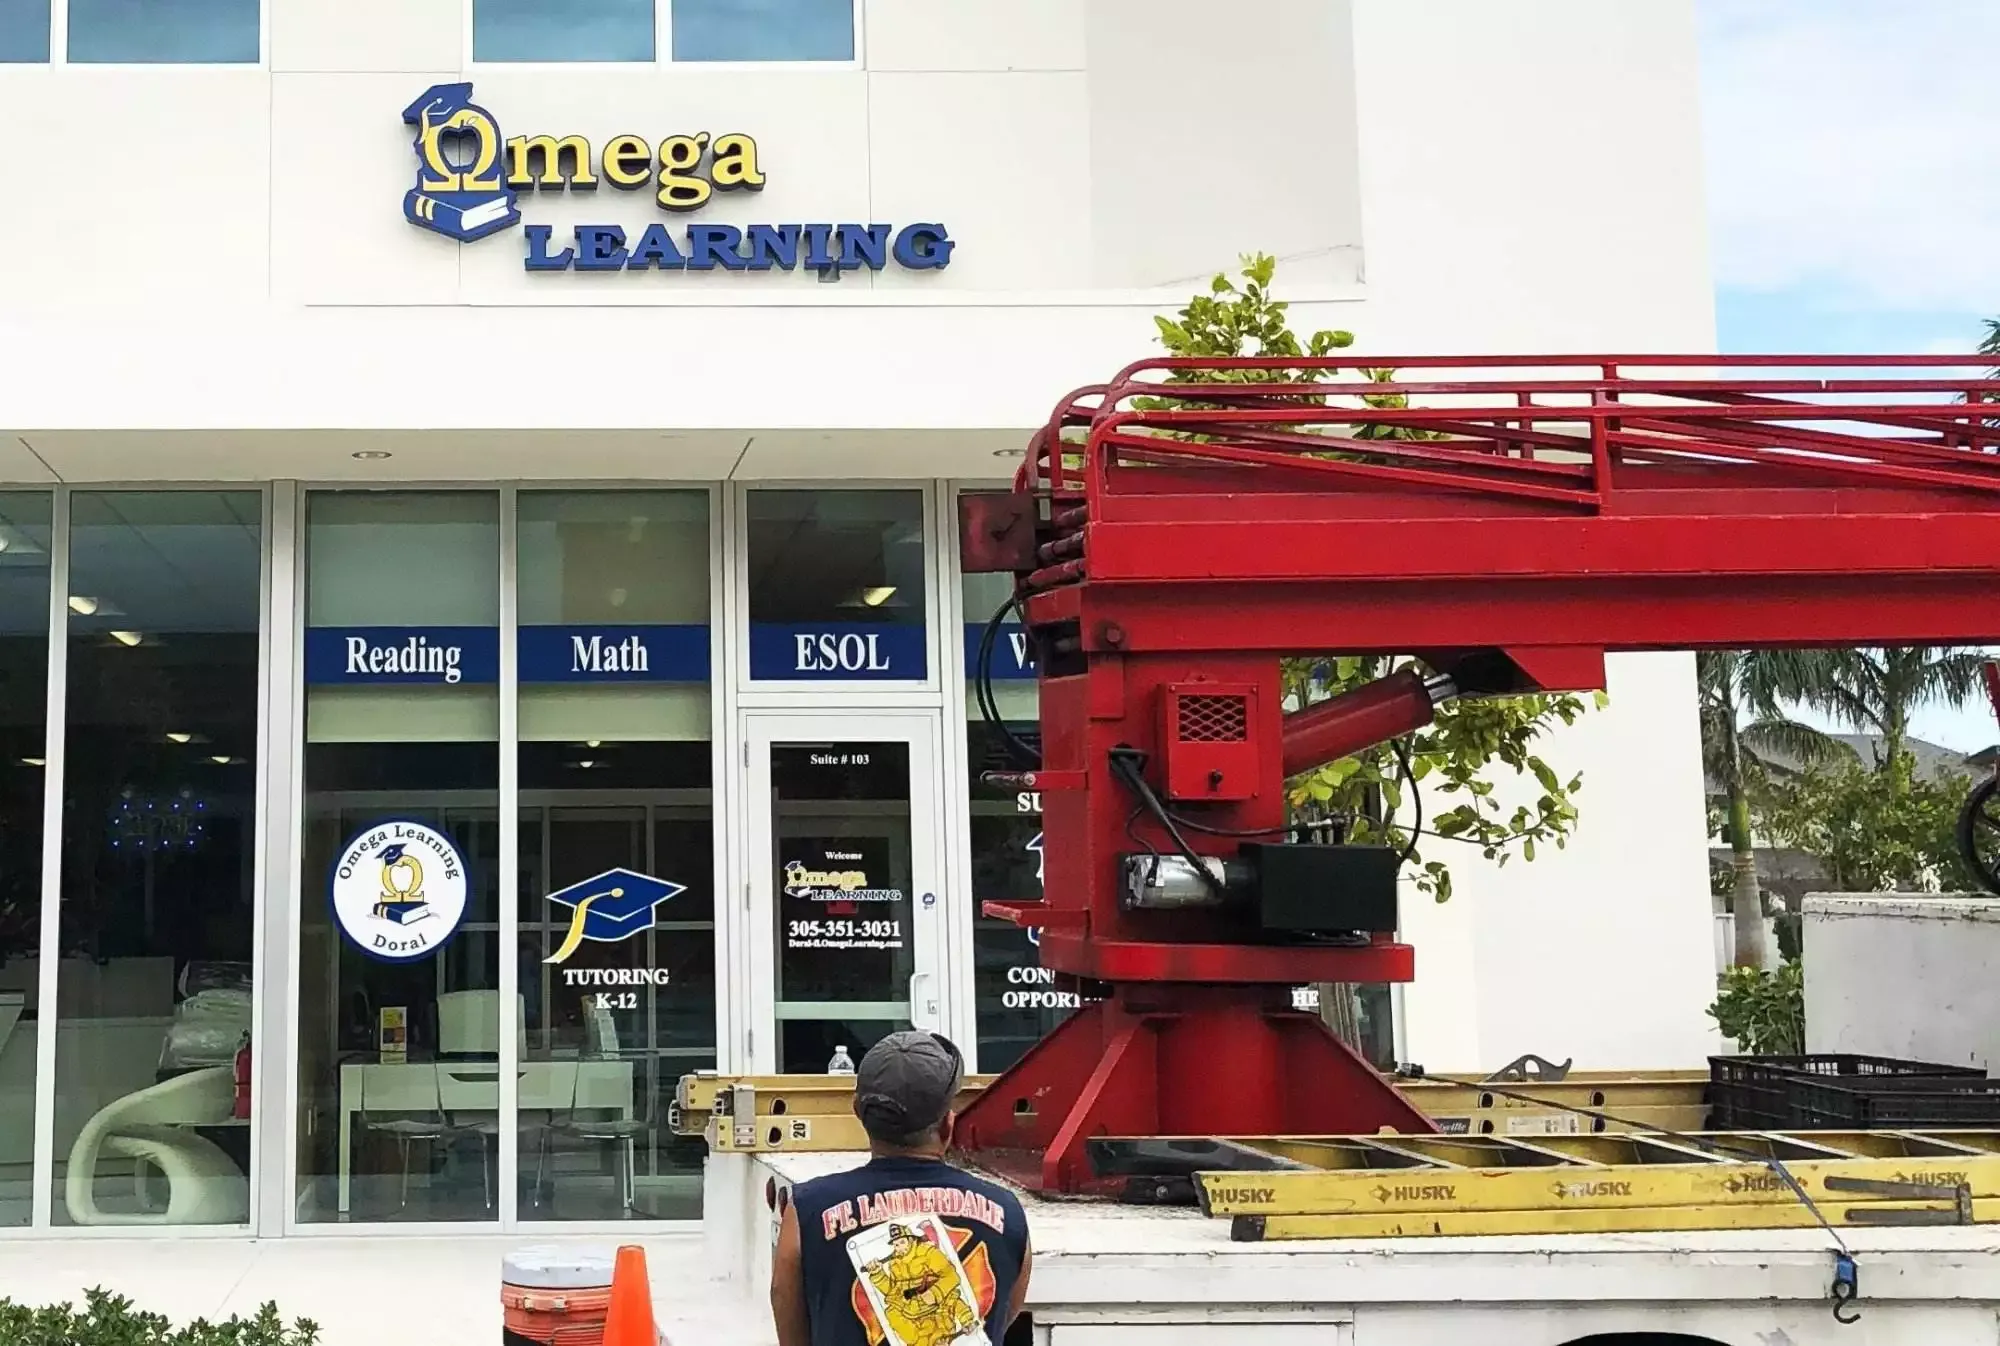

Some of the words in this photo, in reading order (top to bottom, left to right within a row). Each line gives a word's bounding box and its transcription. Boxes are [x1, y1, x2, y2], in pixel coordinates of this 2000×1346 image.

[524, 223, 956, 271] LEARNING
[345, 637, 462, 683] Reading
[571, 636, 649, 672] Math
[794, 633, 890, 671] ESOL
[810, 753, 839, 765] Suite
[841, 754, 849, 765] #
[851, 754, 870, 765] 103
[339, 831, 388, 880] Omega
[394, 825, 460, 880] Learning
[825, 851, 863, 860] Welcome
[811, 889, 902, 901] LEARNING
[788, 920, 901, 937] 305-351-3031
[372, 933, 428, 951] Doral
[563, 968, 670, 985] TUTORING
[595, 992, 637, 1009] K-12
[1912, 1172, 1968, 1187] HUSKY
[1210, 1188, 1276, 1204] HUSKY
[1395, 1185, 1456, 1200] HUSKY
[822, 1199, 859, 1240] FT.
[858, 1187, 1005, 1235] LAUDERDALE
